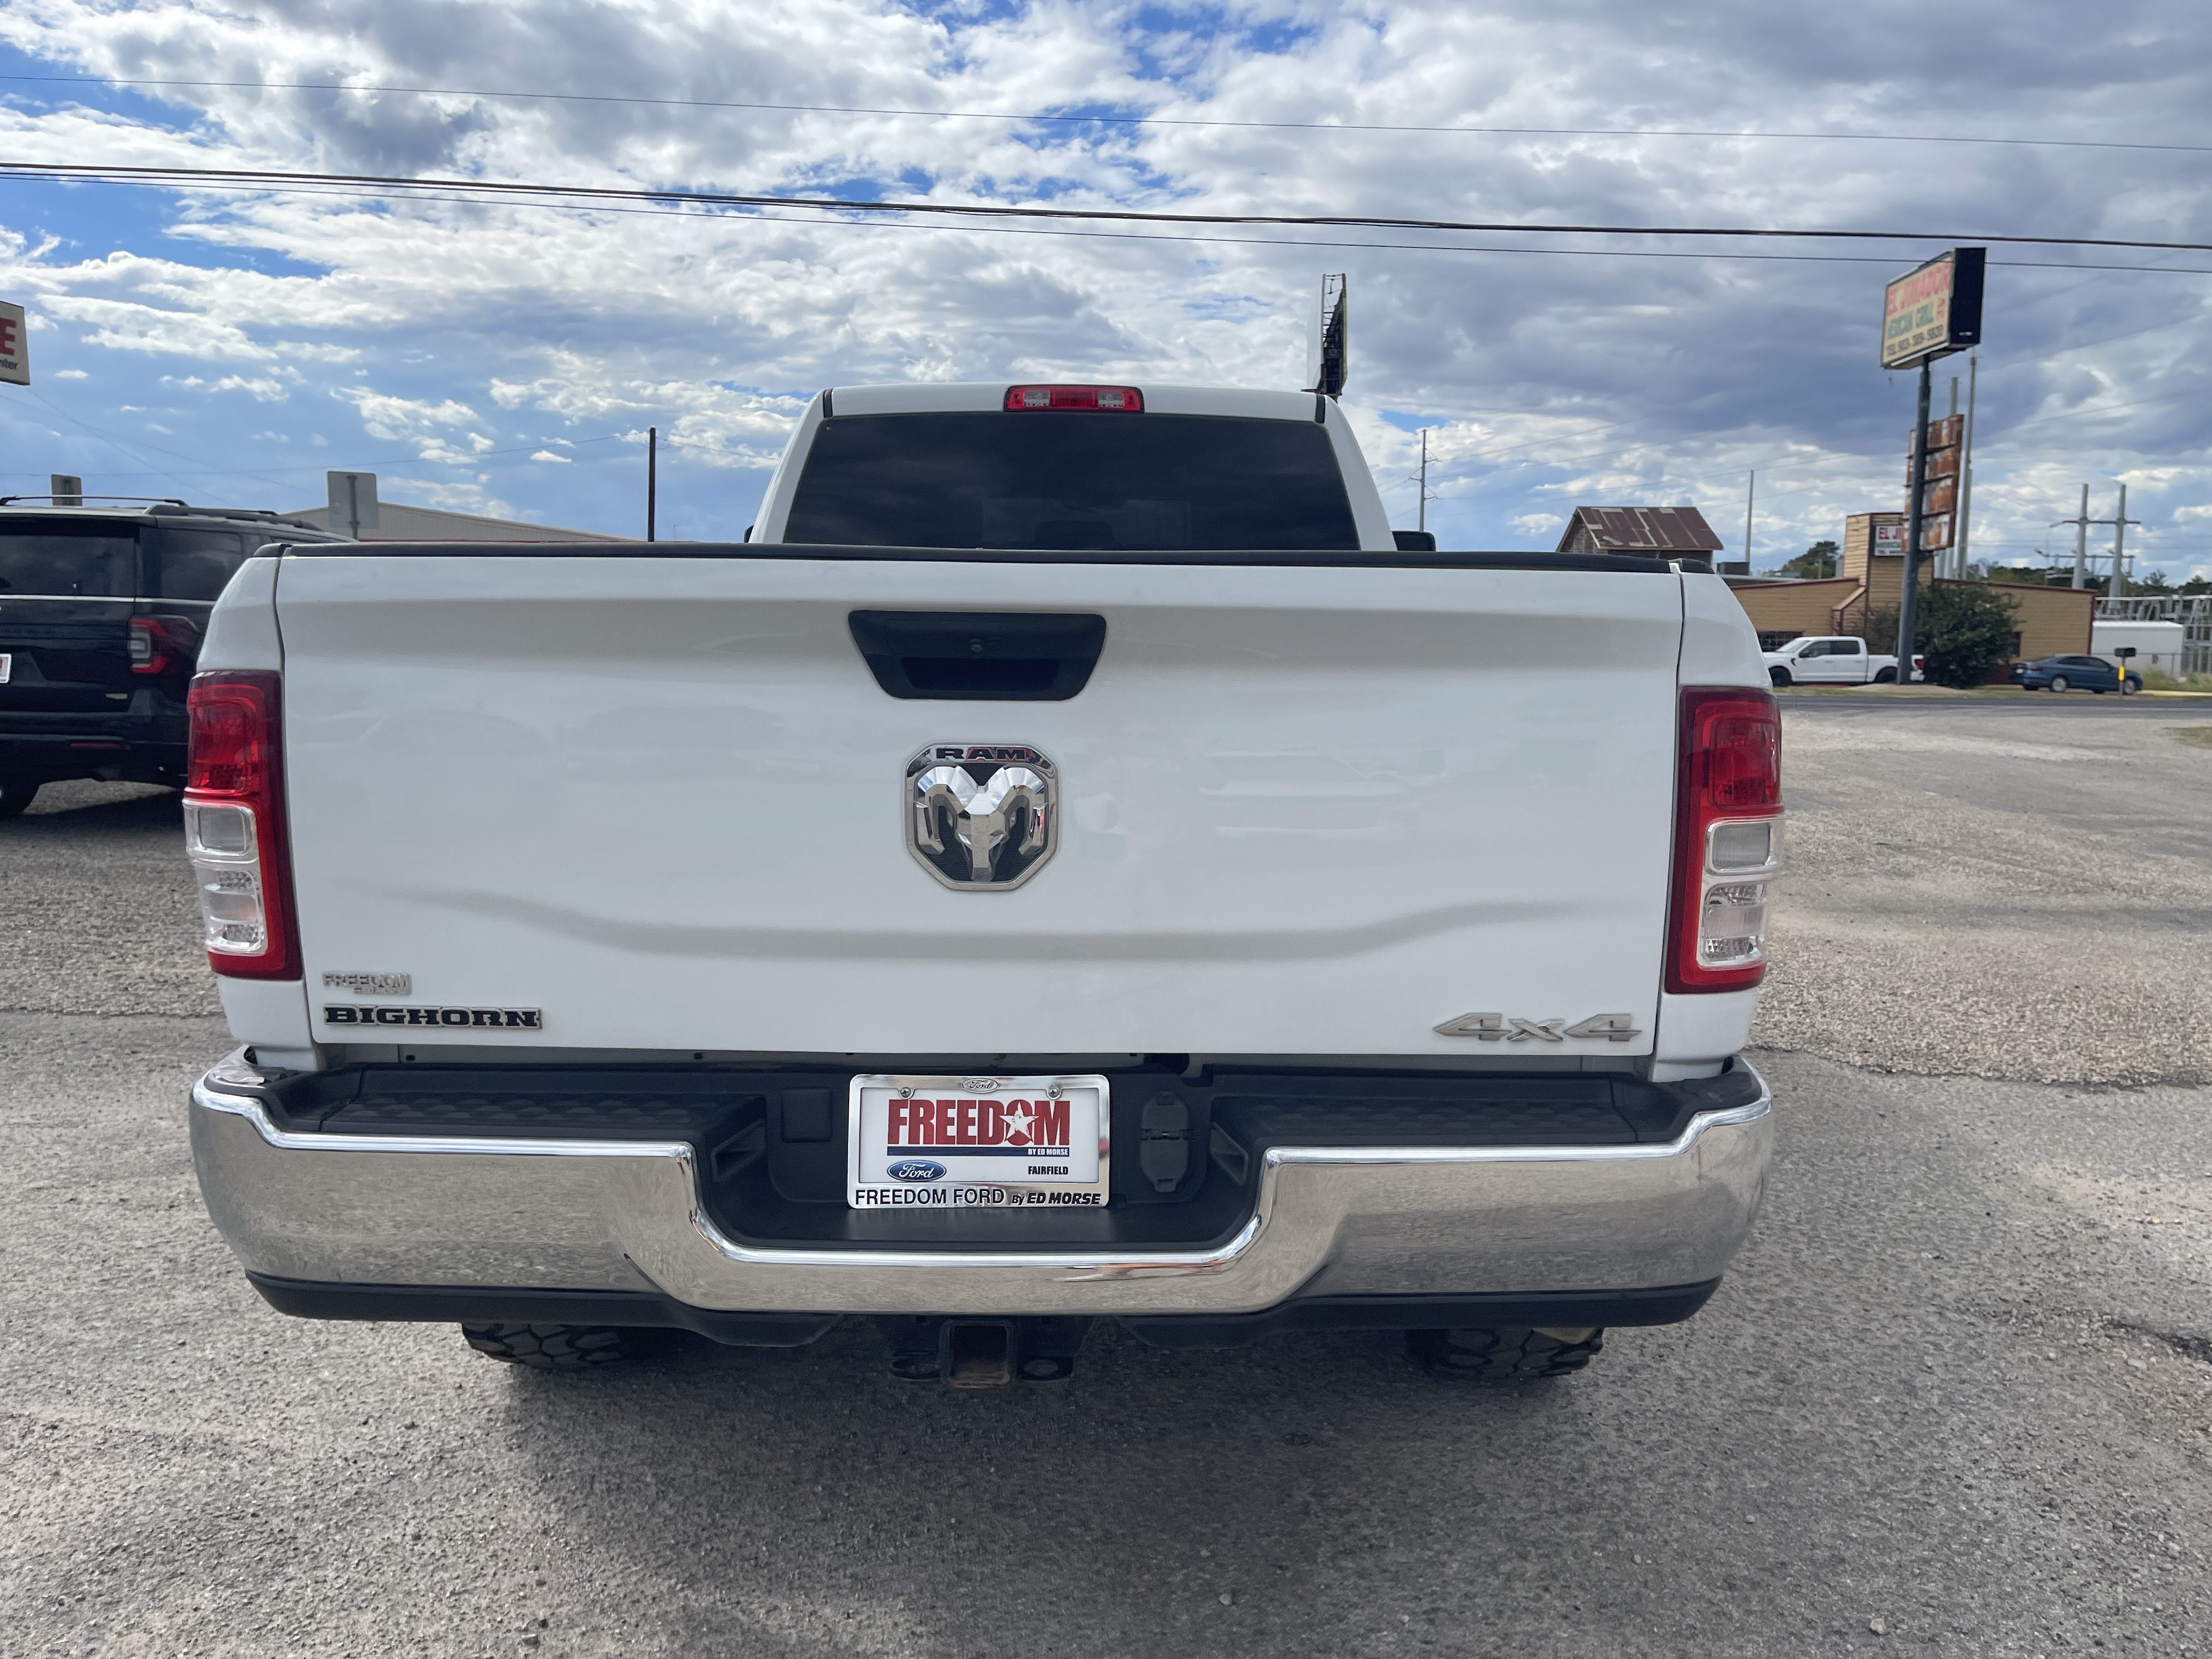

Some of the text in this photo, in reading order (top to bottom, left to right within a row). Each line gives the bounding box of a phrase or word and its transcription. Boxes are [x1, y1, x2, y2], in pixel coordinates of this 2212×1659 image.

[936, 748, 1025, 759] RAM
[324, 1005, 542, 1028] BIGHORN
[969, 1080, 991, 1089] Ford
[887, 1099, 1070, 1146] FREEDOM
[899, 1163, 934, 1178] Ford
[1028, 1166, 1068, 1175] FAIRFIELD
[855, 1188, 1101, 1205] FREEDOM FORD By ED MORSE
